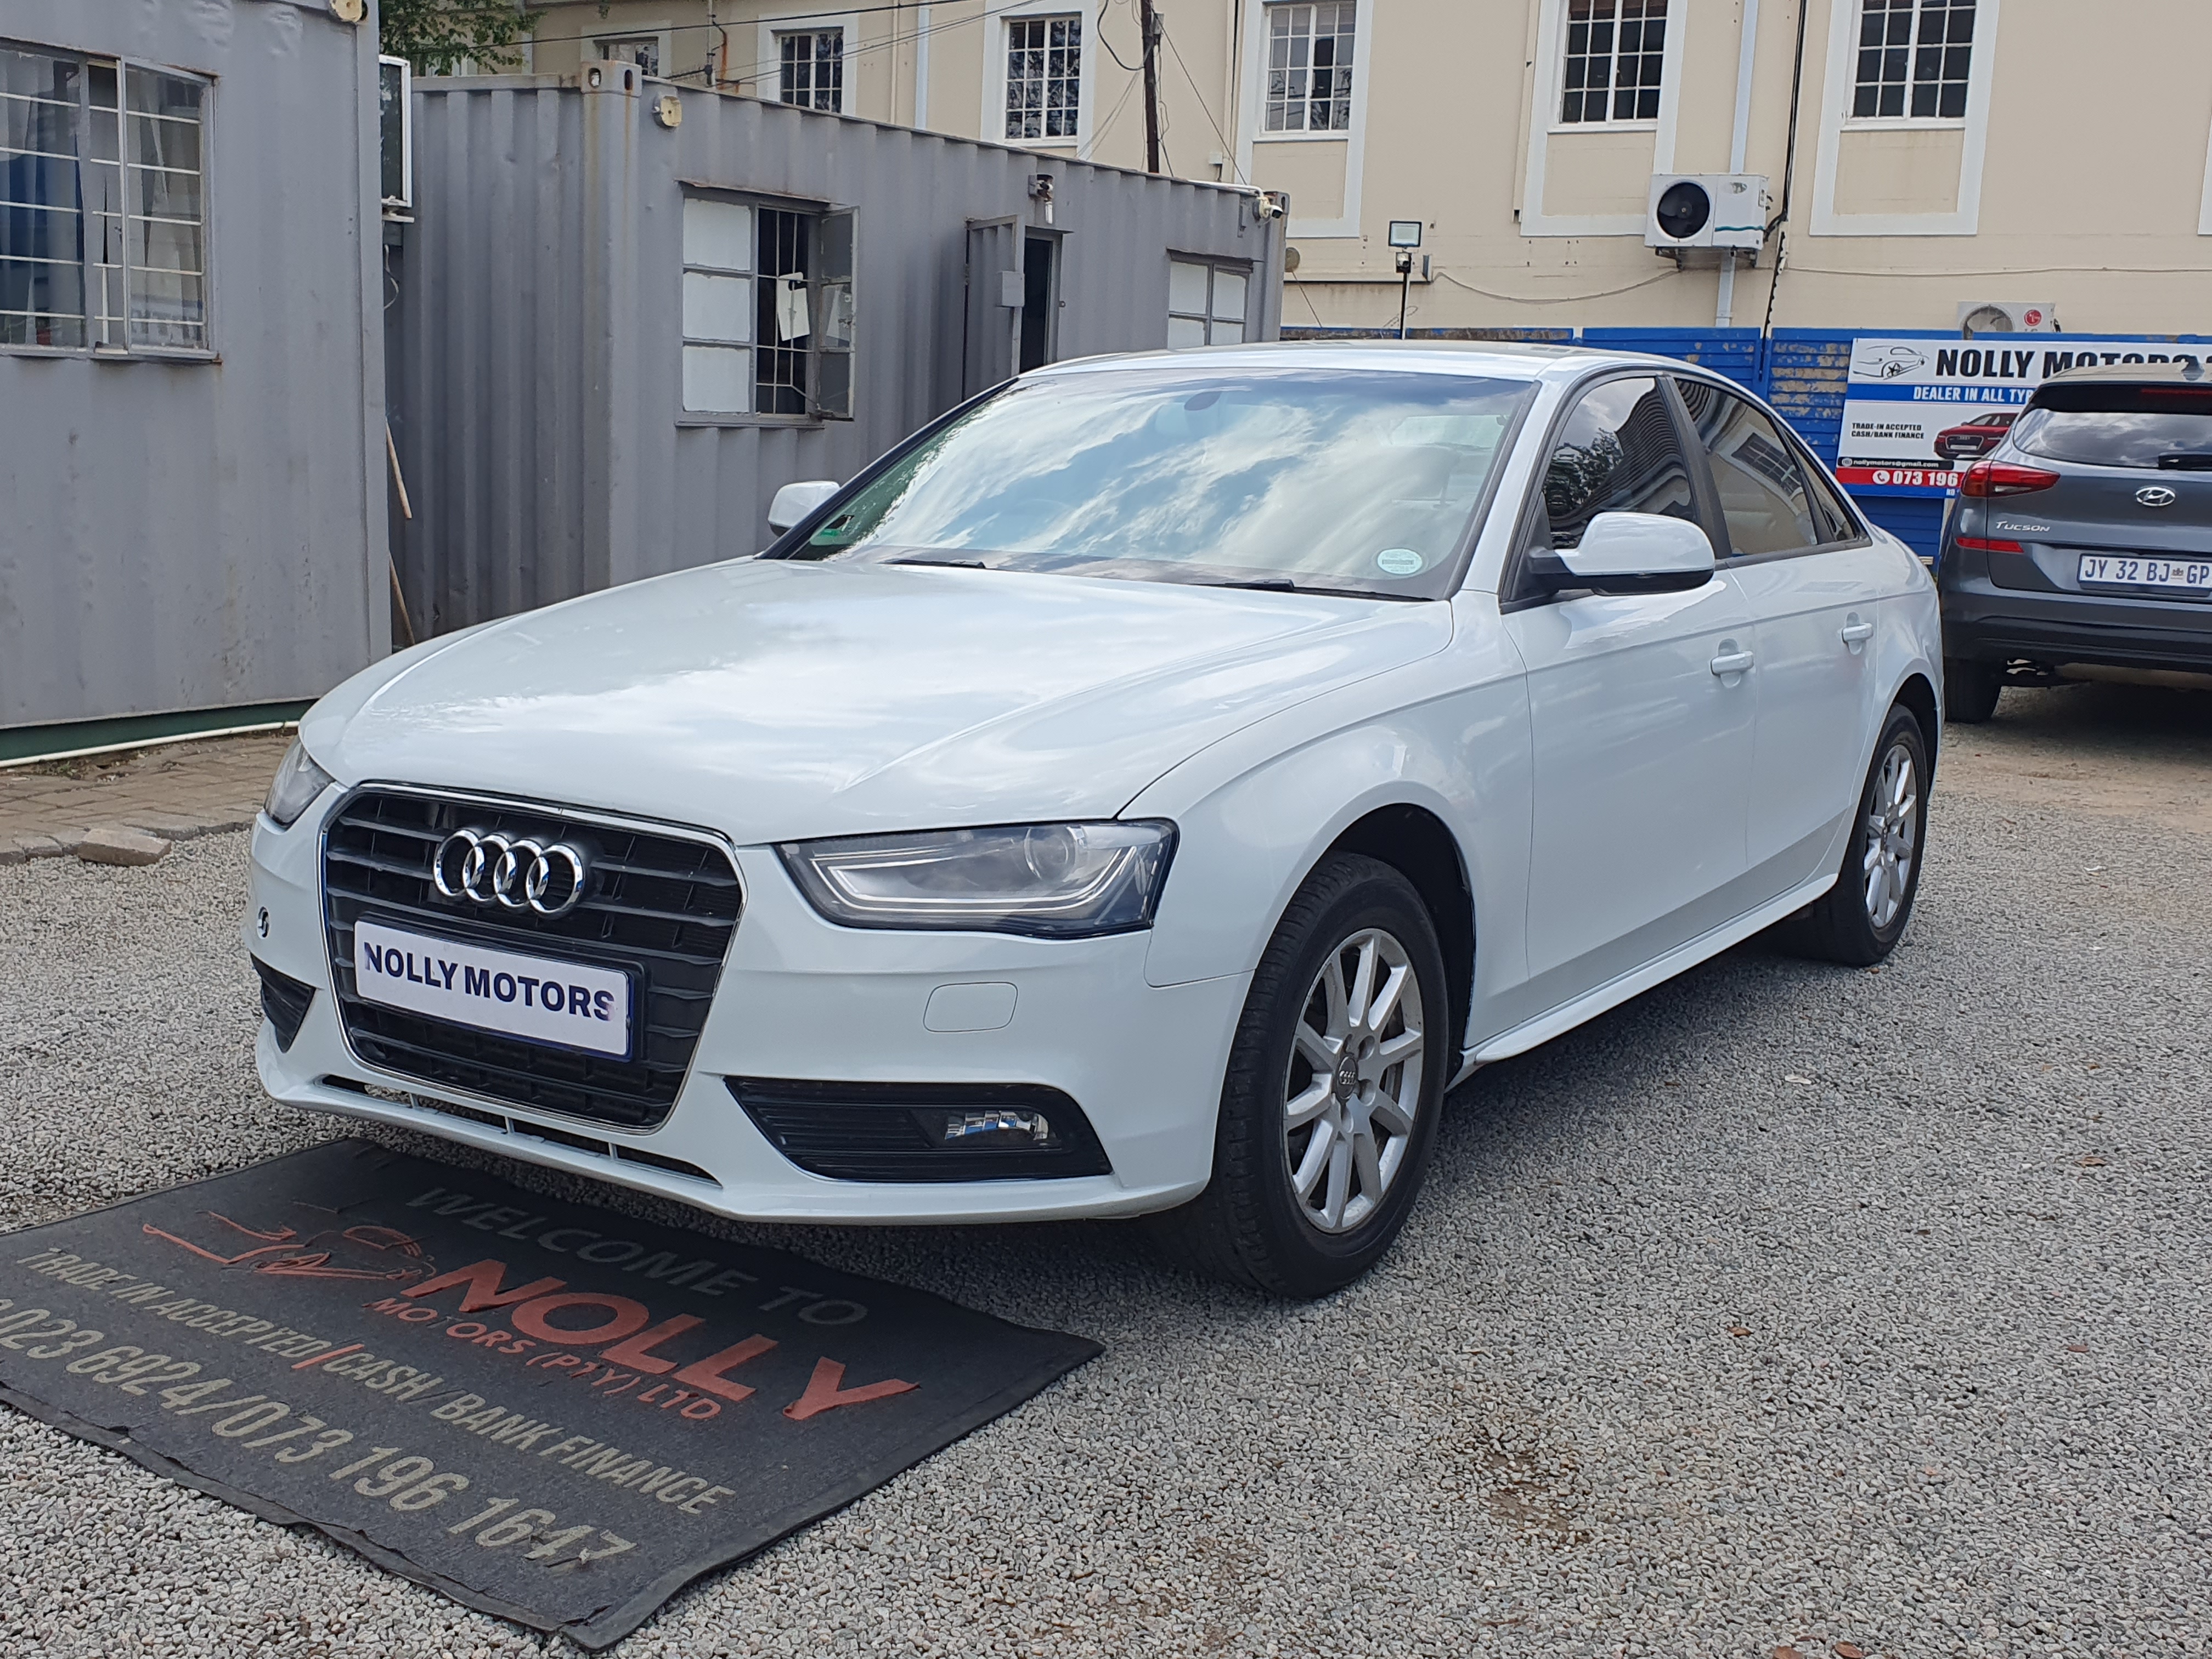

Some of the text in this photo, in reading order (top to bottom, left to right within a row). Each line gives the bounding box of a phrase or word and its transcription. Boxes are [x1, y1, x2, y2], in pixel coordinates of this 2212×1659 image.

[1913, 386, 1961, 400] DEALER
[1964, 387, 1978, 401] IN
[1981, 388, 2005, 403] ALL
[1936, 349, 2035, 379] NOLLY
[1893, 470, 1959, 487] 073 196
[2085, 558, 2210, 585] JY 32 BJ GP
[364, 941, 615, 1022] NOLLY MOTORS
[404, 1187, 868, 1325] WELCOME TO
[16, 1247, 138, 1290] TRADE
[109, 1282, 175, 1304] IN
[538, 1434, 736, 1515] FINANCE
[362, 1297, 721, 1419] MOTORS (PTY) LTD
[400, 1258, 920, 1420] NOLLY
[329, 1447, 470, 1511] 196
[447, 1497, 637, 1564] 1647
